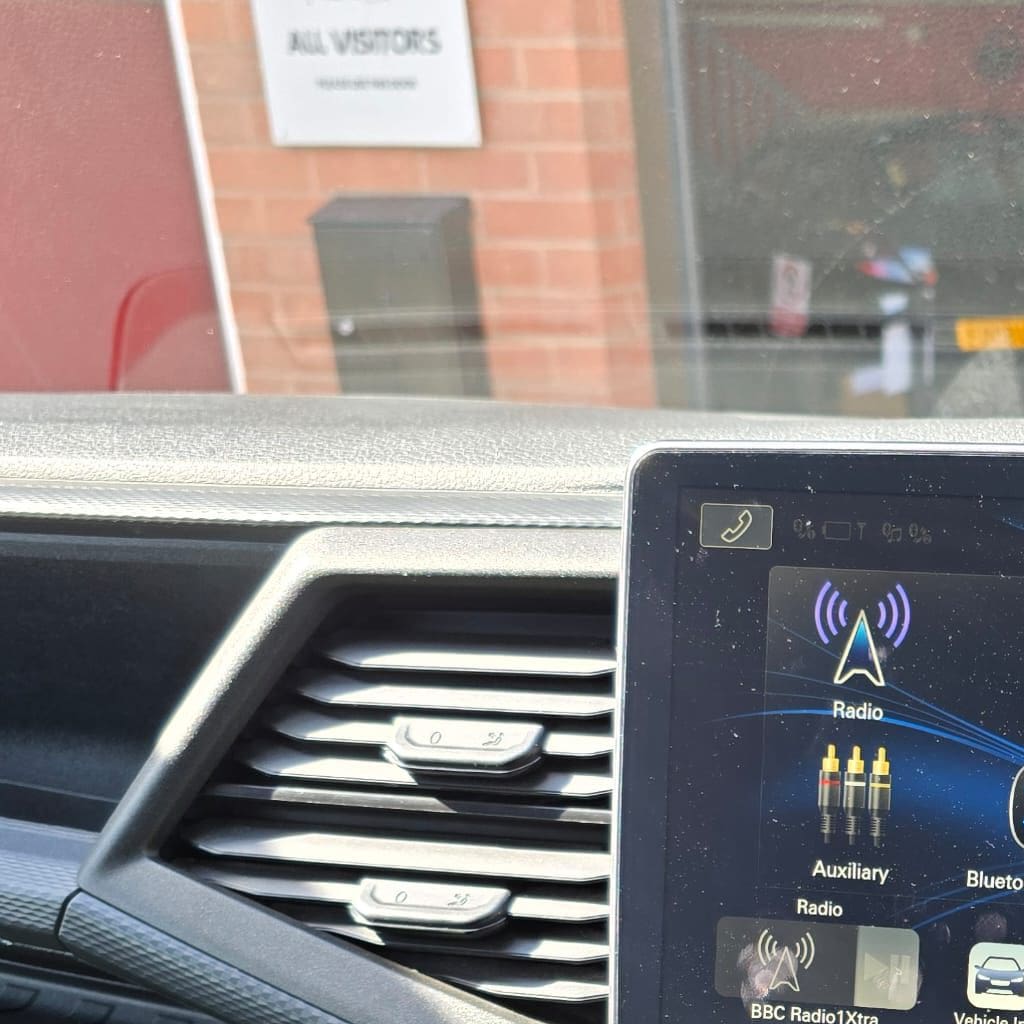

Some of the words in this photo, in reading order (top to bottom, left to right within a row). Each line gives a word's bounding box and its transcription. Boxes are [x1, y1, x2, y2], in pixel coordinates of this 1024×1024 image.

[289, 29, 327, 56] ALL
[330, 28, 442, 56] VISITORS
[832, 700, 885, 722] Radio
[811, 860, 890, 885] Auxiliary
[796, 898, 844, 918] Radio
[750, 1003, 786, 1022] BBC
